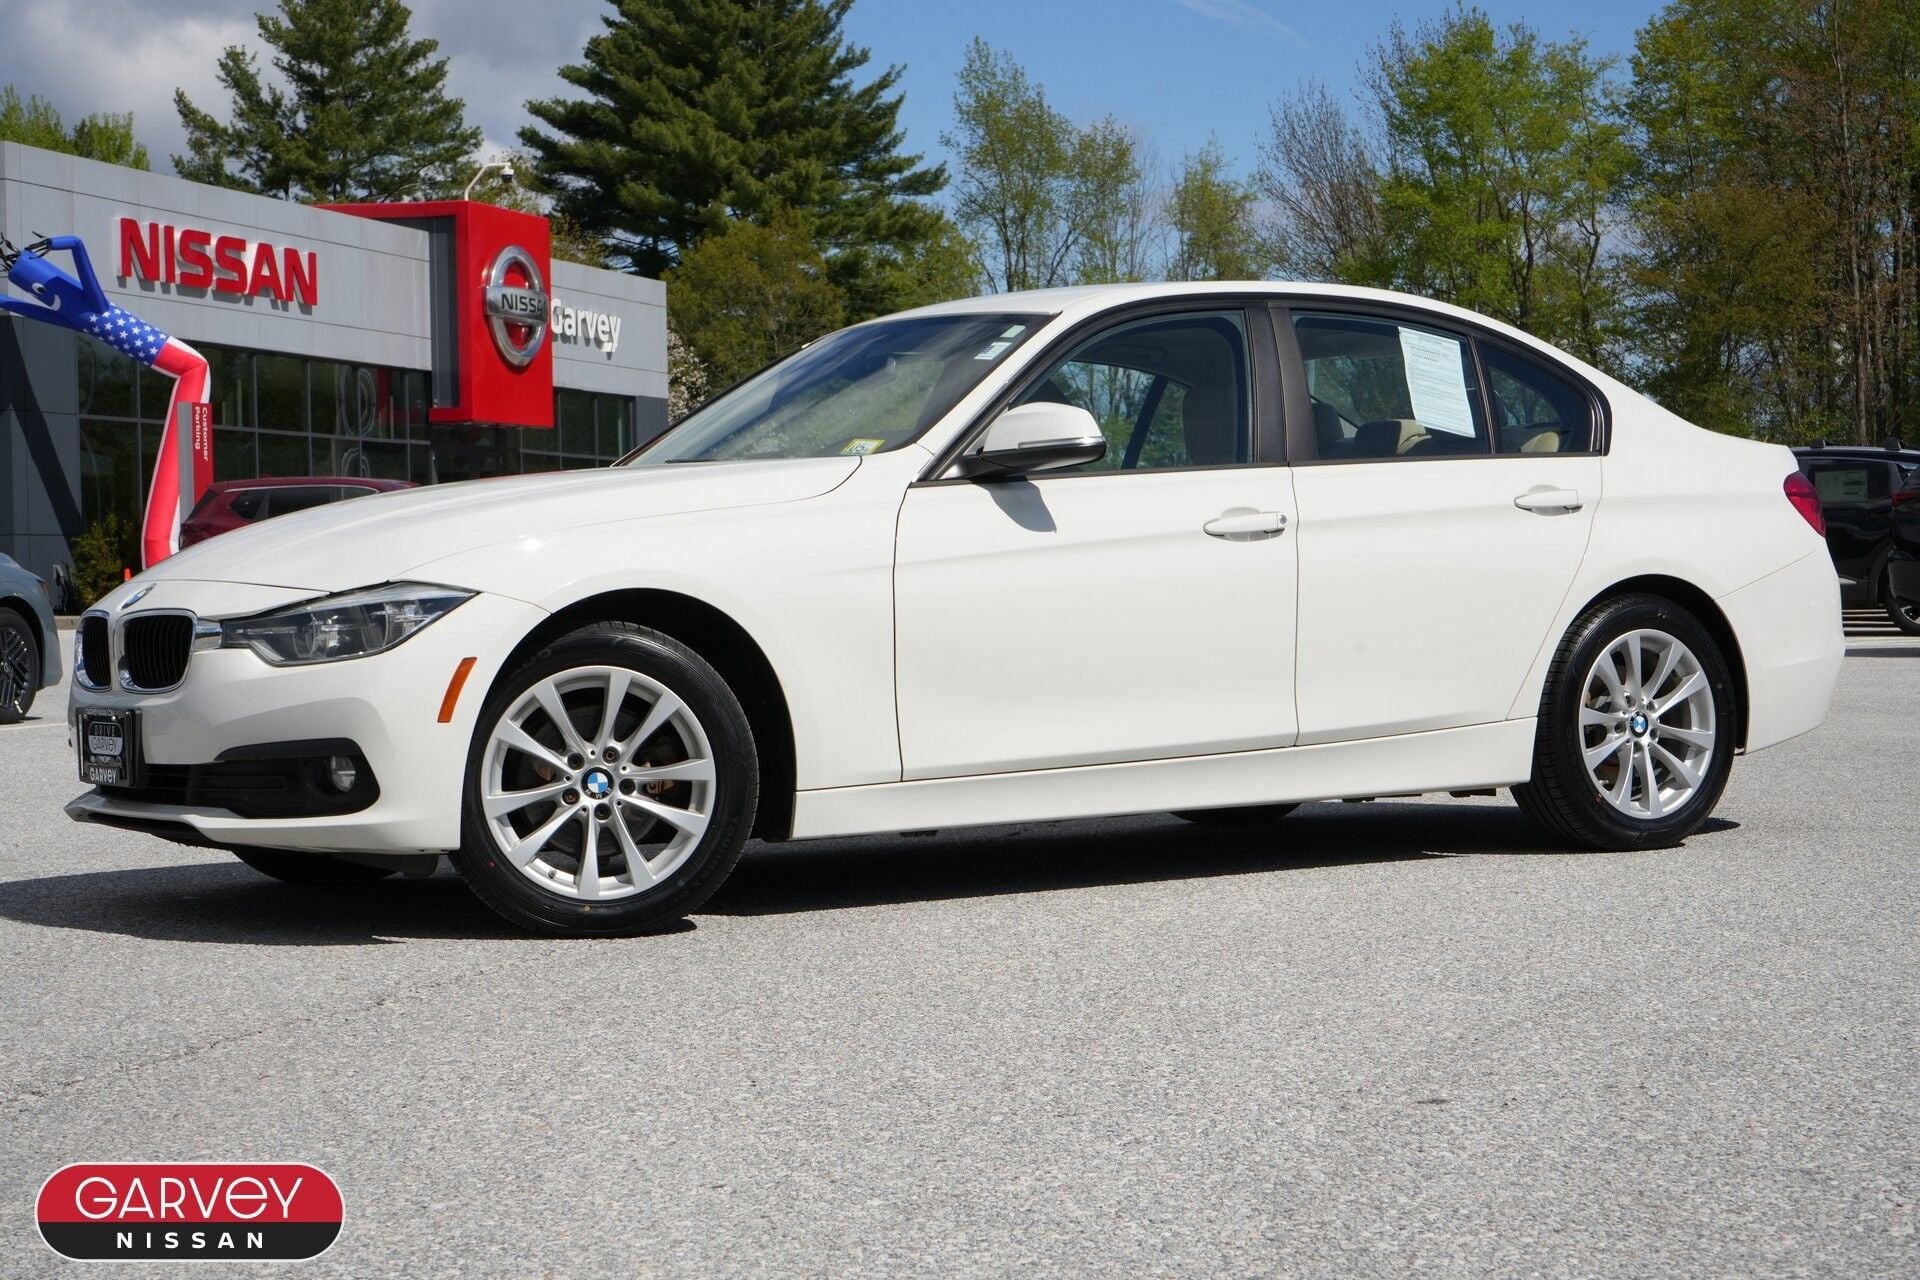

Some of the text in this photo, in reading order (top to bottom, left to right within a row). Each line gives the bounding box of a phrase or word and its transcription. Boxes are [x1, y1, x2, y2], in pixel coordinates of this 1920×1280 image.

[120, 217, 318, 306] NISSAN
[551, 297, 621, 352] Garvey
[94, 724, 116, 737] DRIVE
